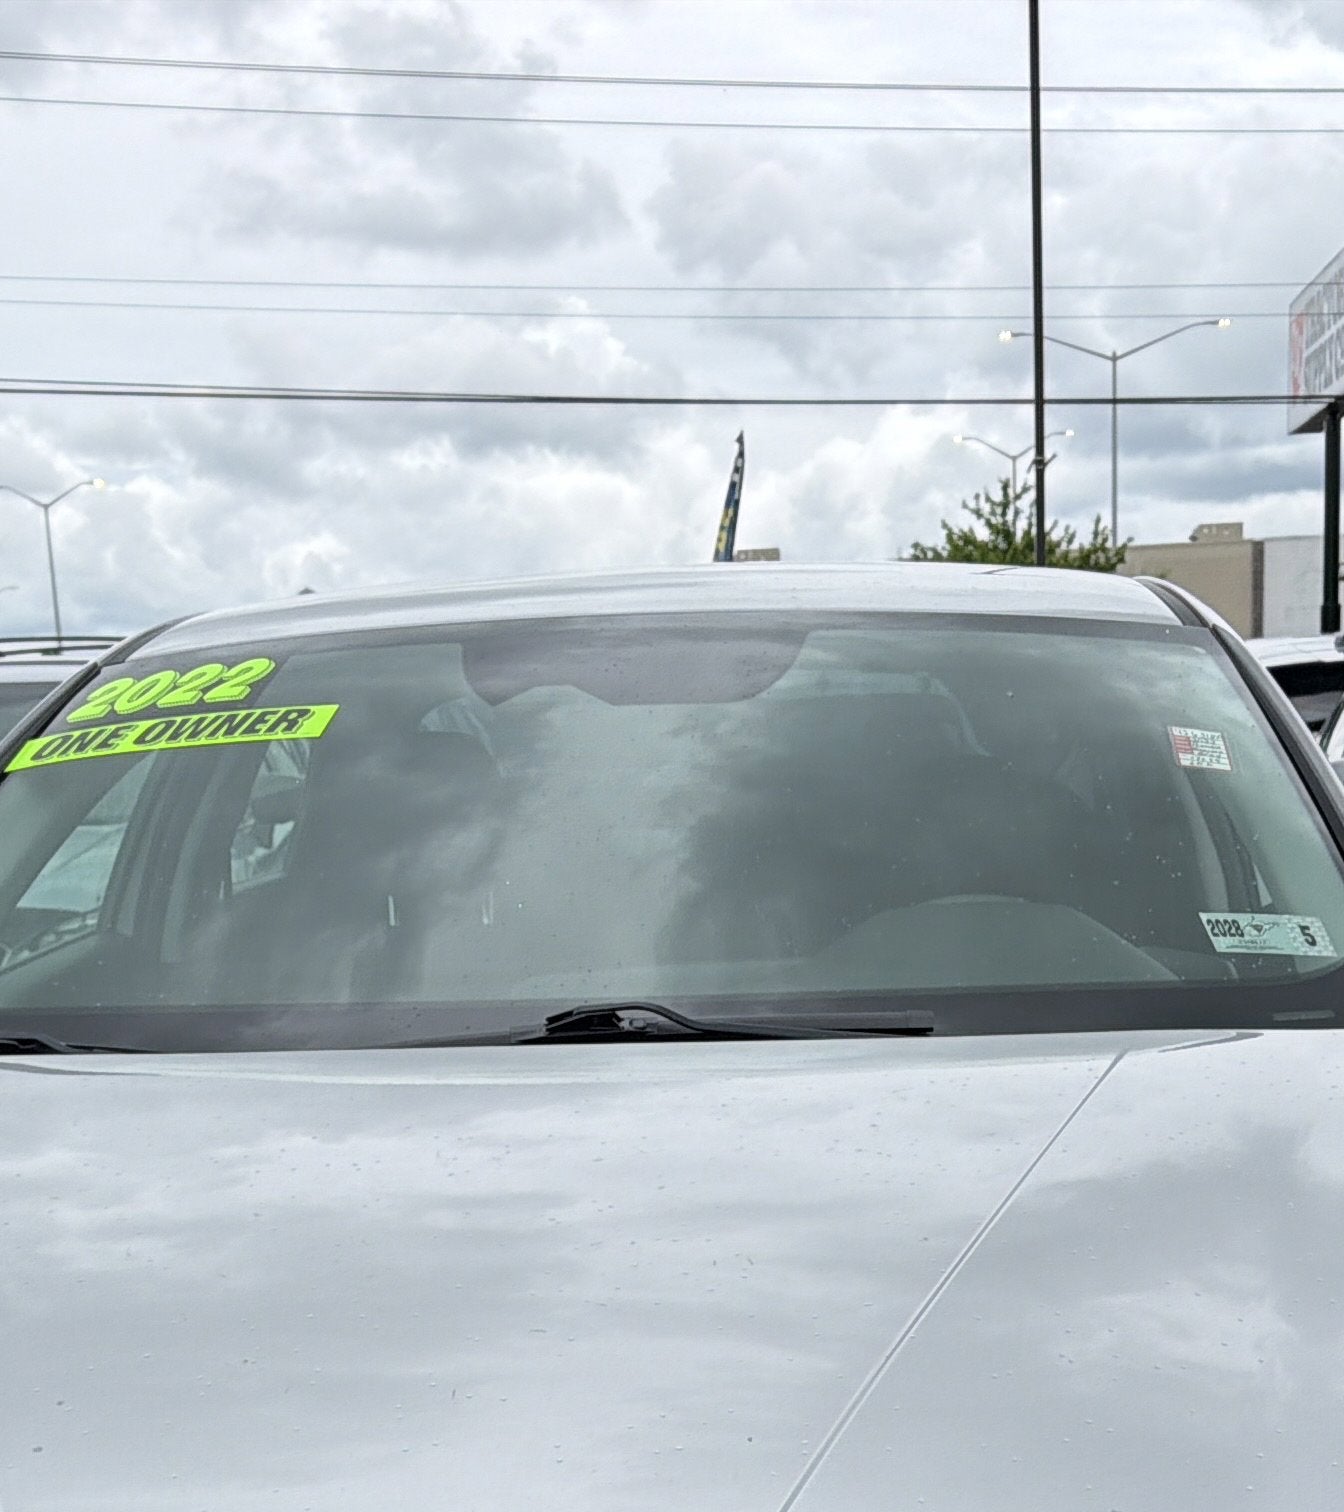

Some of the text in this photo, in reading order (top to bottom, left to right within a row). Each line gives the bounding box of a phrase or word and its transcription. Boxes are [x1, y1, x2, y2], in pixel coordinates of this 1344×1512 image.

[67, 657, 276, 723] 2022
[30, 707, 316, 762] ONE OWNER
[1206, 918, 1318, 947] 2028 5
